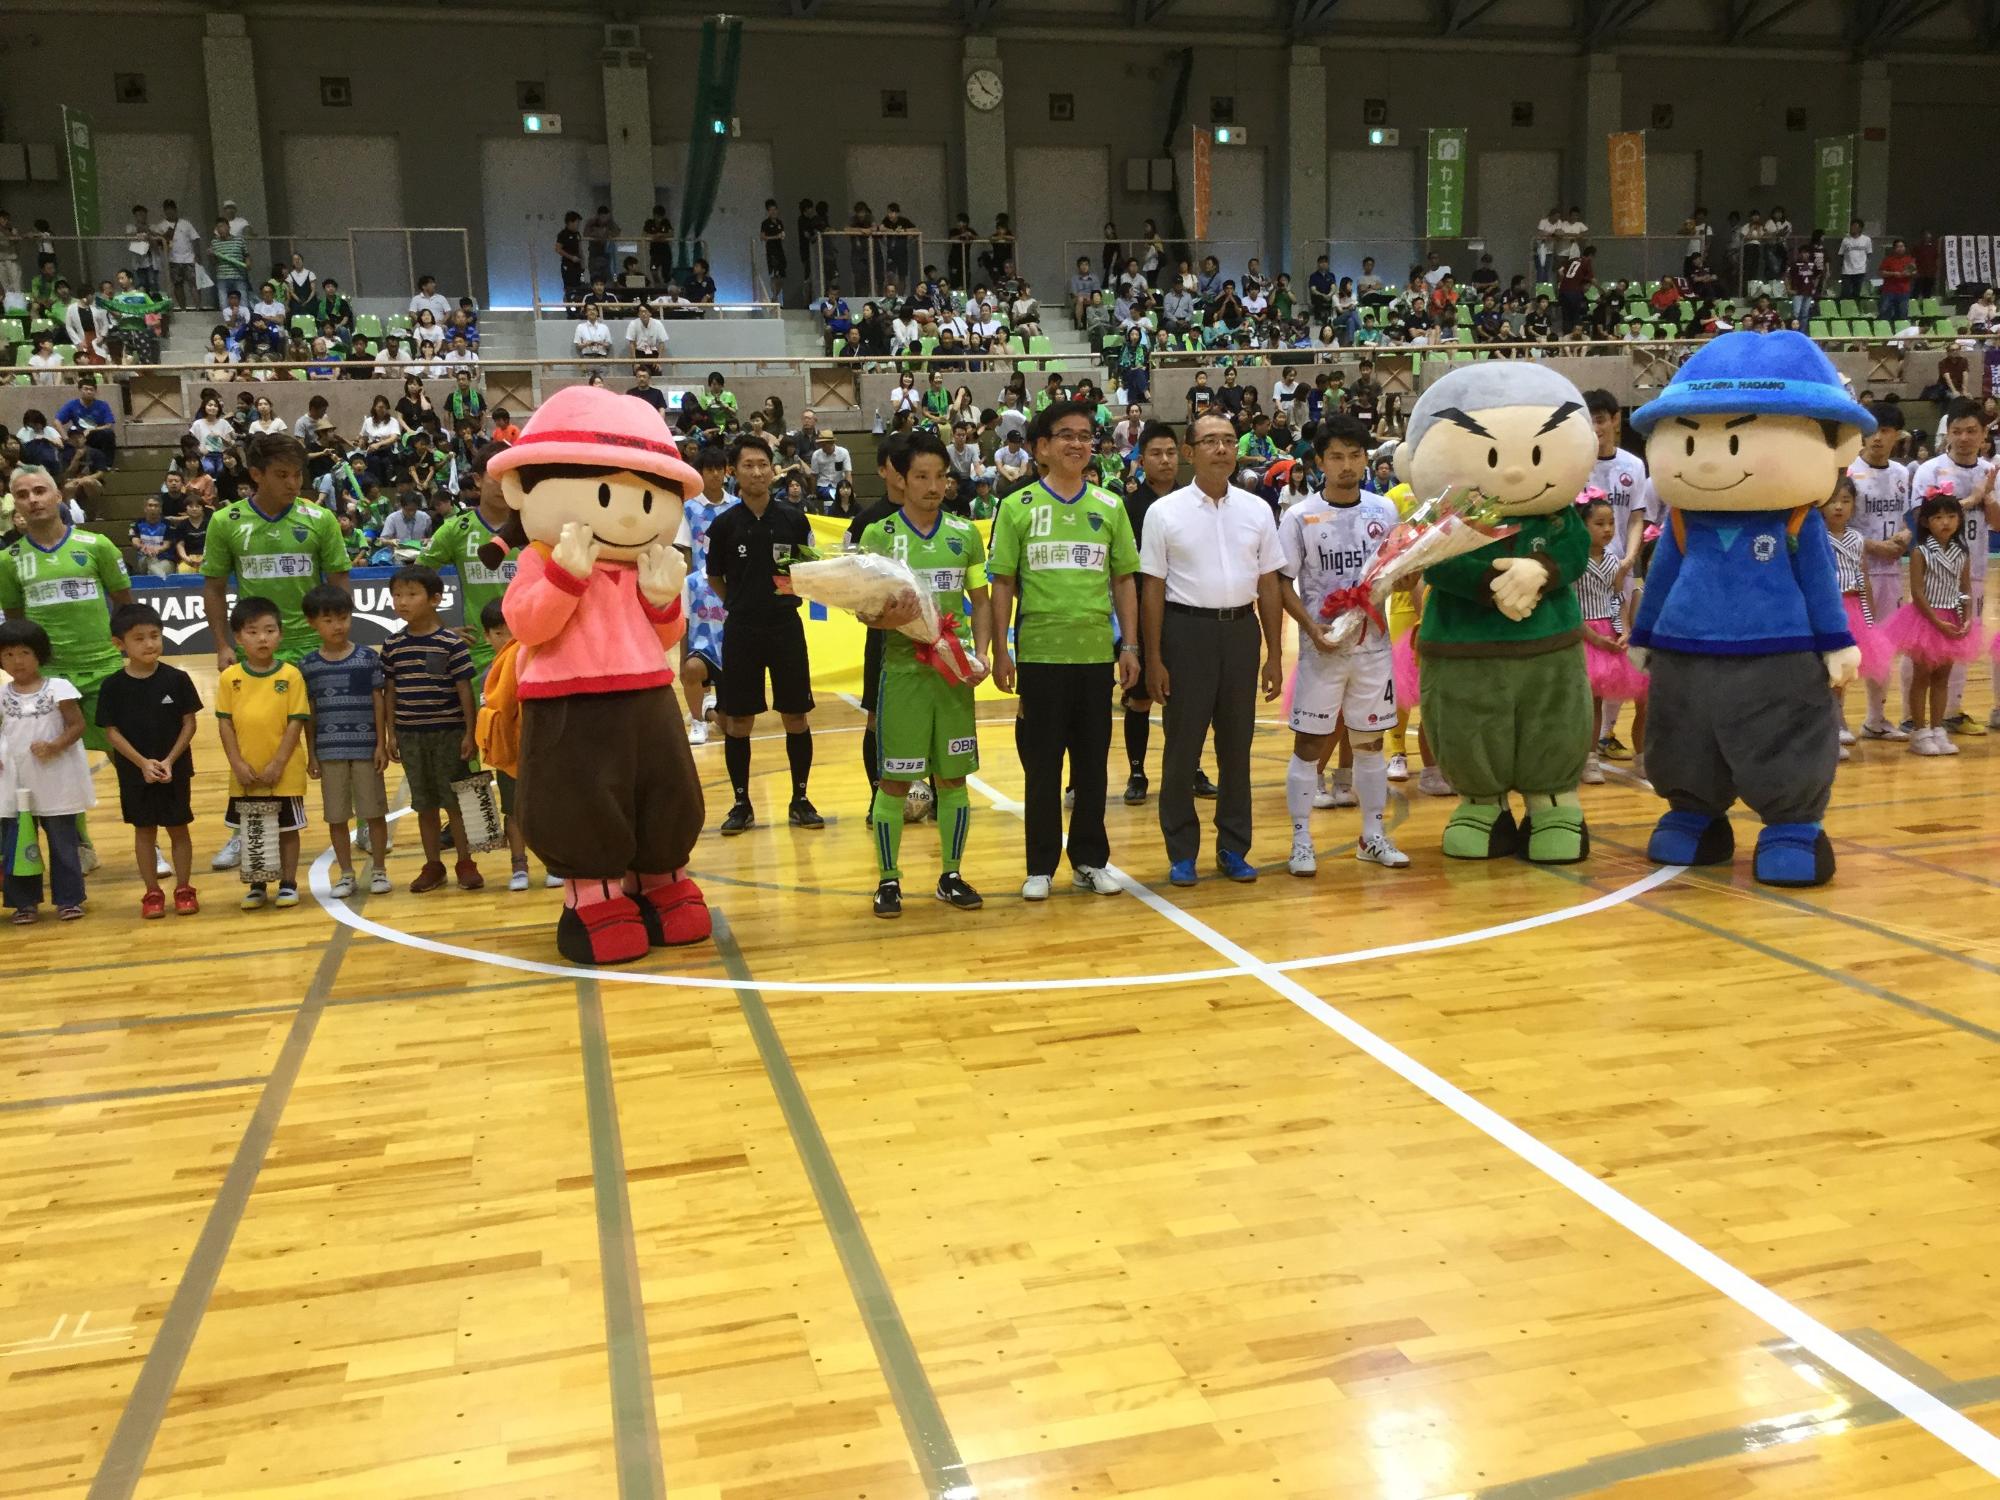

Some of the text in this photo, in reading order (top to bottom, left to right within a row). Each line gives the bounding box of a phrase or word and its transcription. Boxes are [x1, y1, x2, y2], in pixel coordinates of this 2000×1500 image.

[1440, 166, 1453, 231] カナエル
[1029, 505, 1053, 537] 18
[1883, 521, 1896, 540] 17
[240, 523, 254, 551] 7
[466, 531, 480, 557] 6
[893, 534, 908, 561] 8
[14, 552, 37, 580] 10
[240, 555, 312, 575] 湘南電力
[1030, 543, 1105, 568] 湘南電力
[25, 580, 97, 602] 湘南電力
[1384, 679, 1394, 704] 4
